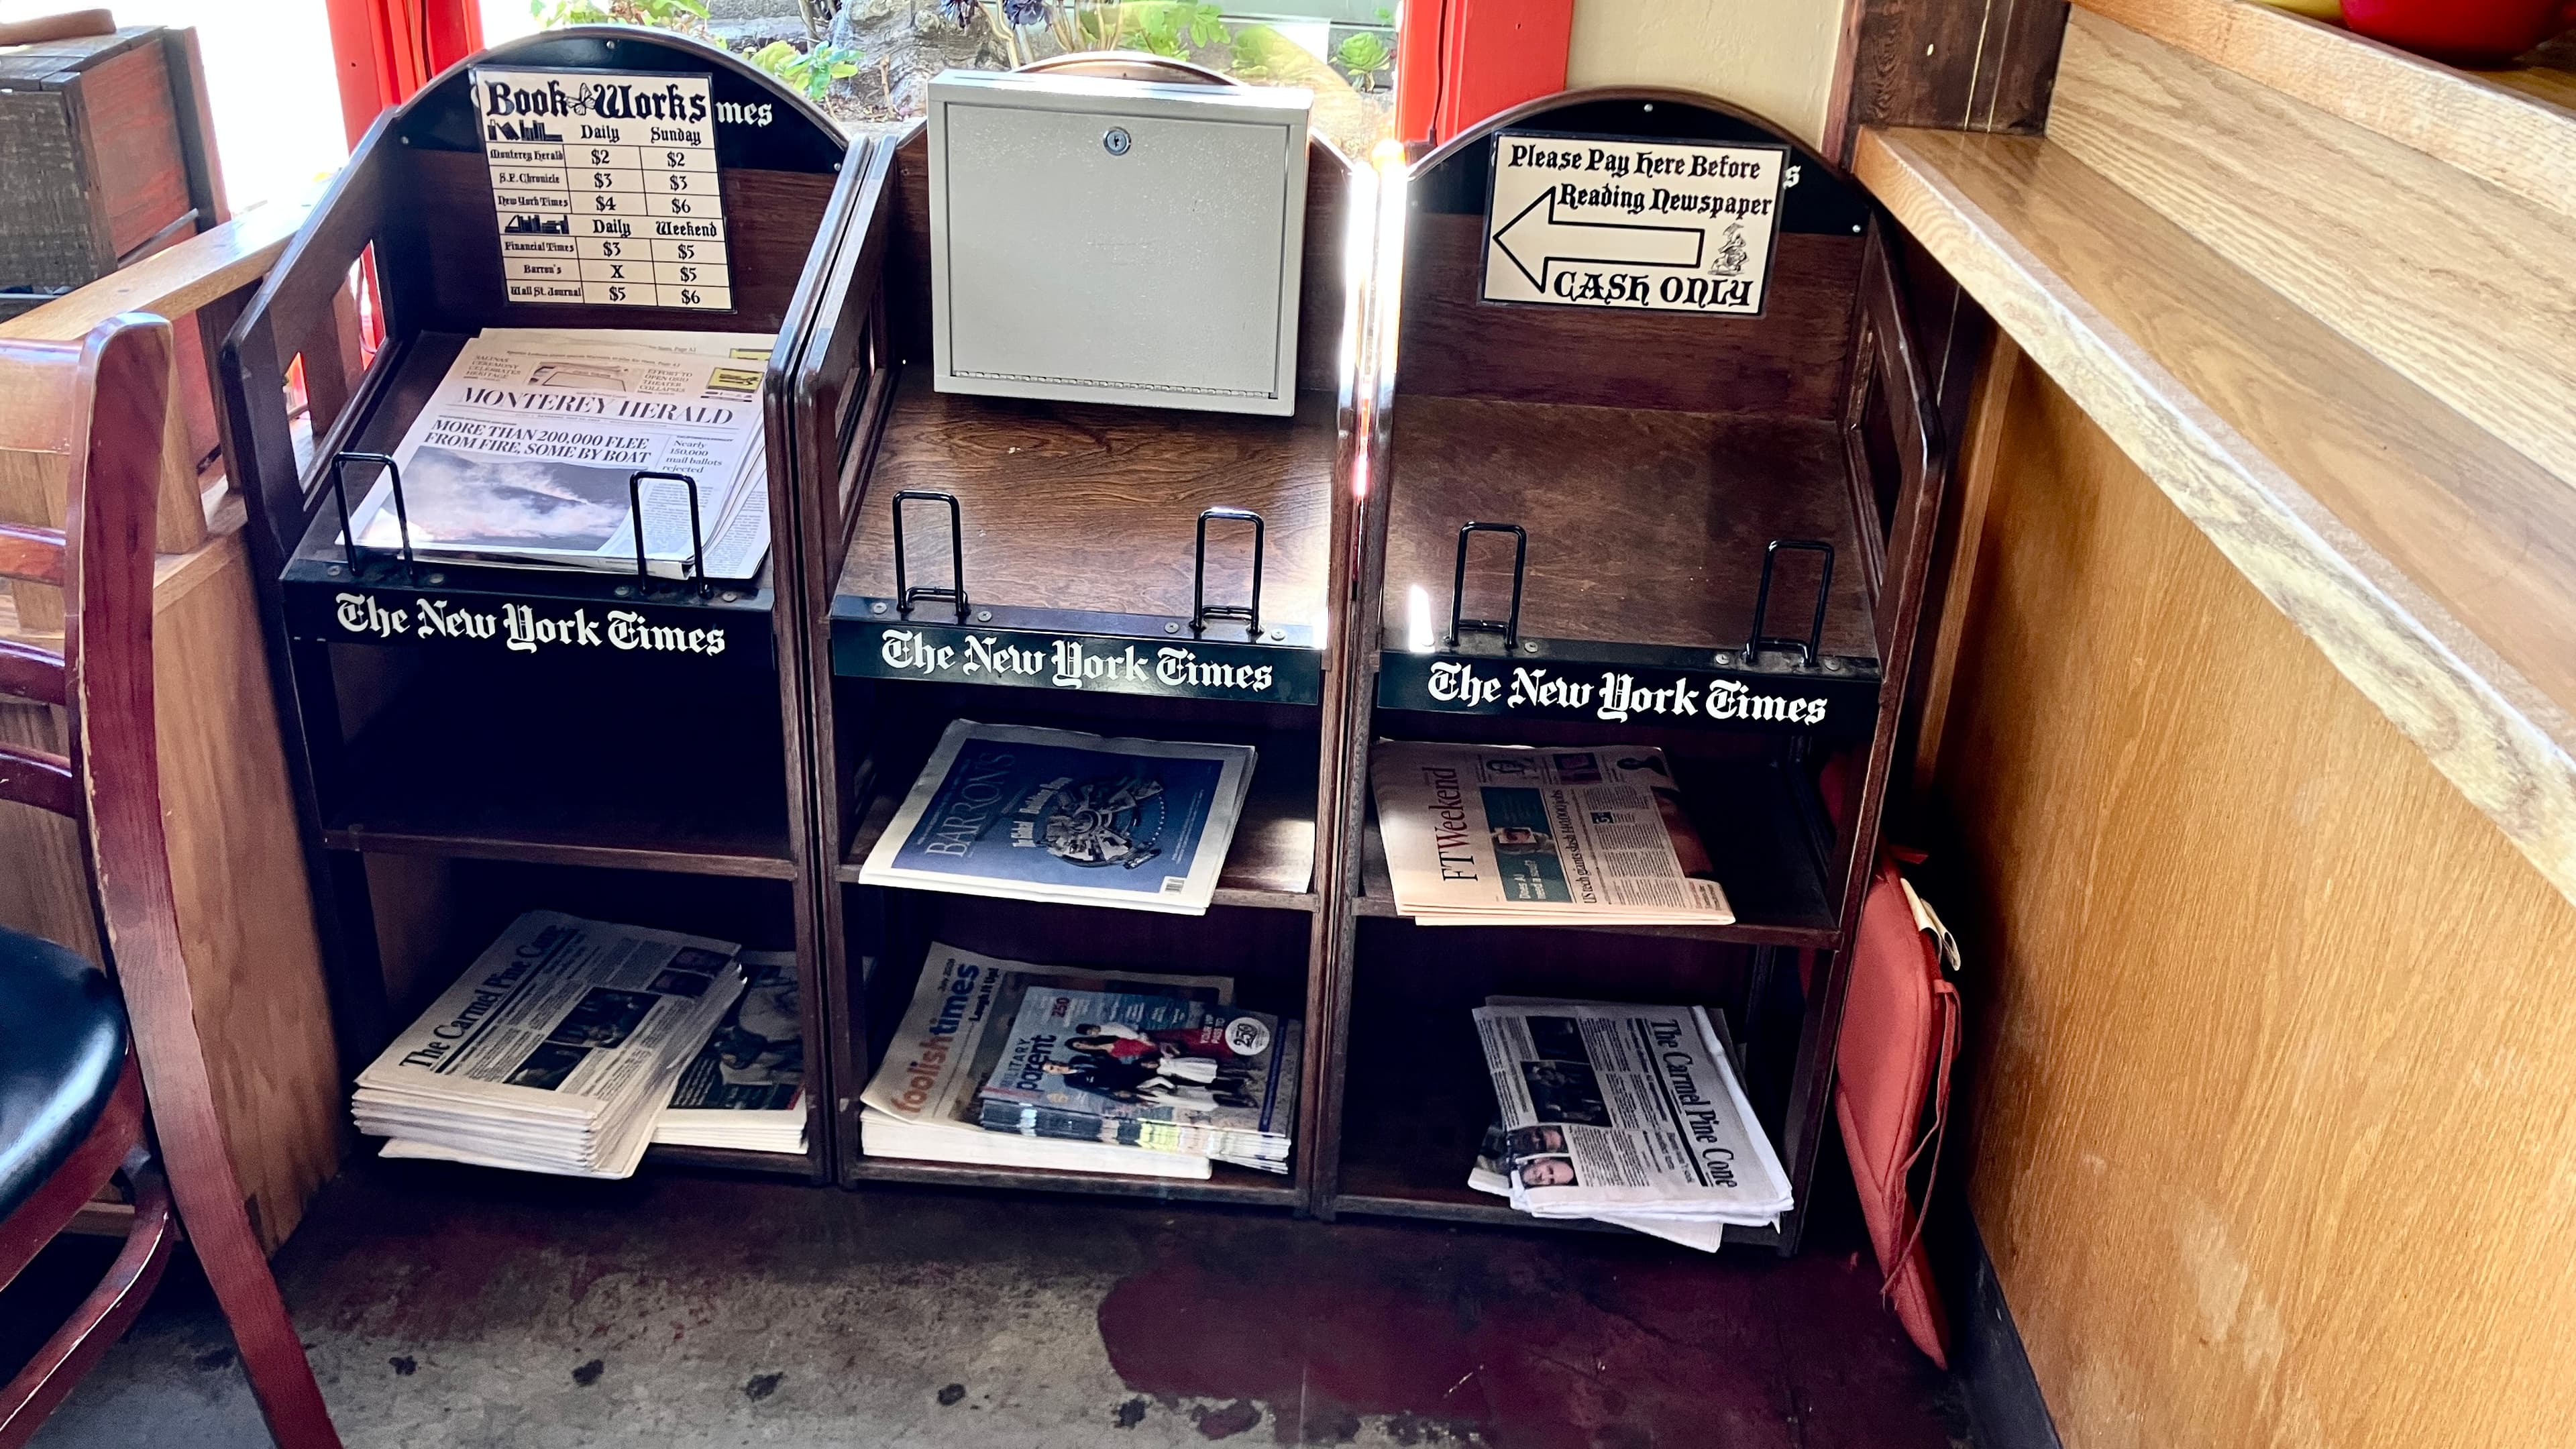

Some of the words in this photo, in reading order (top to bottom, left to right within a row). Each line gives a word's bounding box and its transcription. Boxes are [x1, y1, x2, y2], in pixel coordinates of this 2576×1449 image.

[484, 80, 569, 117] Book
[594, 84, 706, 123] Works
[714, 101, 773, 126] mes
[581, 124, 620, 143] Daily
[651, 127, 702, 146] Sunday
[490, 149, 532, 161] Monterey
[534, 150, 564, 161] Herald
[591, 149, 610, 165] $2
[667, 152, 685, 167] $2
[1509, 145, 1581, 169] Please
[1585, 148, 1629, 178] Pay
[1633, 152, 1685, 178] Here
[1688, 155, 1761, 180] Before
[519, 173, 559, 183] Chronicle
[594, 172, 612, 188] $3
[670, 174, 687, 191] $3
[498, 195, 517, 206] New
[518, 196, 539, 206] York
[539, 197, 568, 207] Times
[596, 195, 616, 211] $4
[672, 198, 690, 213] $6
[1557, 183, 1645, 214] Reading
[1649, 189, 1773, 220] Newspaper
[593, 219, 631, 237] Daily
[656, 221, 717, 237] Weekend
[505, 241, 545, 251] Financial
[546, 242, 574, 252] Times
[603, 241, 621, 257] $3
[678, 244, 694, 260] $5
[524, 264, 561, 274] Barron's
[610, 264, 624, 278] X
[680, 266, 696, 282] $5
[511, 286, 532, 295] Wall
[548, 287, 581, 296] Journal
[609, 286, 626, 301] $5
[682, 289, 700, 305] $6
[1554, 272, 1649, 306] CASH
[1660, 276, 1754, 308] ONLY
[461, 387, 614, 414] MONTEREY
[619, 400, 733, 425] HERALD
[431, 419, 483, 435] MORE
[488, 426, 538, 441] THAN
[537, 430, 603, 447] 200,000
[605, 436, 650, 449] FLEE
[674, 440, 707, 449] Nearly
[423, 432, 479, 449] FROM
[479, 439, 522, 454] FIRE,
[524, 443, 576, 458] SOME
[578, 447, 604, 460] BY
[604, 450, 651, 463] BOAT
[662, 465, 704, 474] rejected
[690, 458, 722, 466] ballots
[336, 592, 411, 638] The
[416, 598, 498, 639] New
[502, 603, 603, 654] York
[607, 610, 726, 657] Times
[881, 629, 956, 675] The
[963, 634, 1046, 676] New
[1051, 639, 1150, 690] York
[1155, 647, 1273, 693] Times
[1427, 661, 1502, 708] The
[1507, 667, 1595, 708] New
[1597, 672, 1700, 724] York
[1705, 679, 1828, 727] Times
[1563, 835, 1580, 852] slash
[1572, 853, 1589, 875] giants
[1576, 876, 1593, 892] tech
[399, 1040, 450, 1068] The
[434, 989, 502, 1039] Carmel
[484, 961, 531, 988] Pine
[1051, 996, 1070, 1017] 250
[1651, 1020, 1682, 1049] The
[1663, 1051, 1711, 1107] Carmel
[1684, 1108, 1719, 1144] Pine
[1703, 1148, 1738, 1189] Cone
